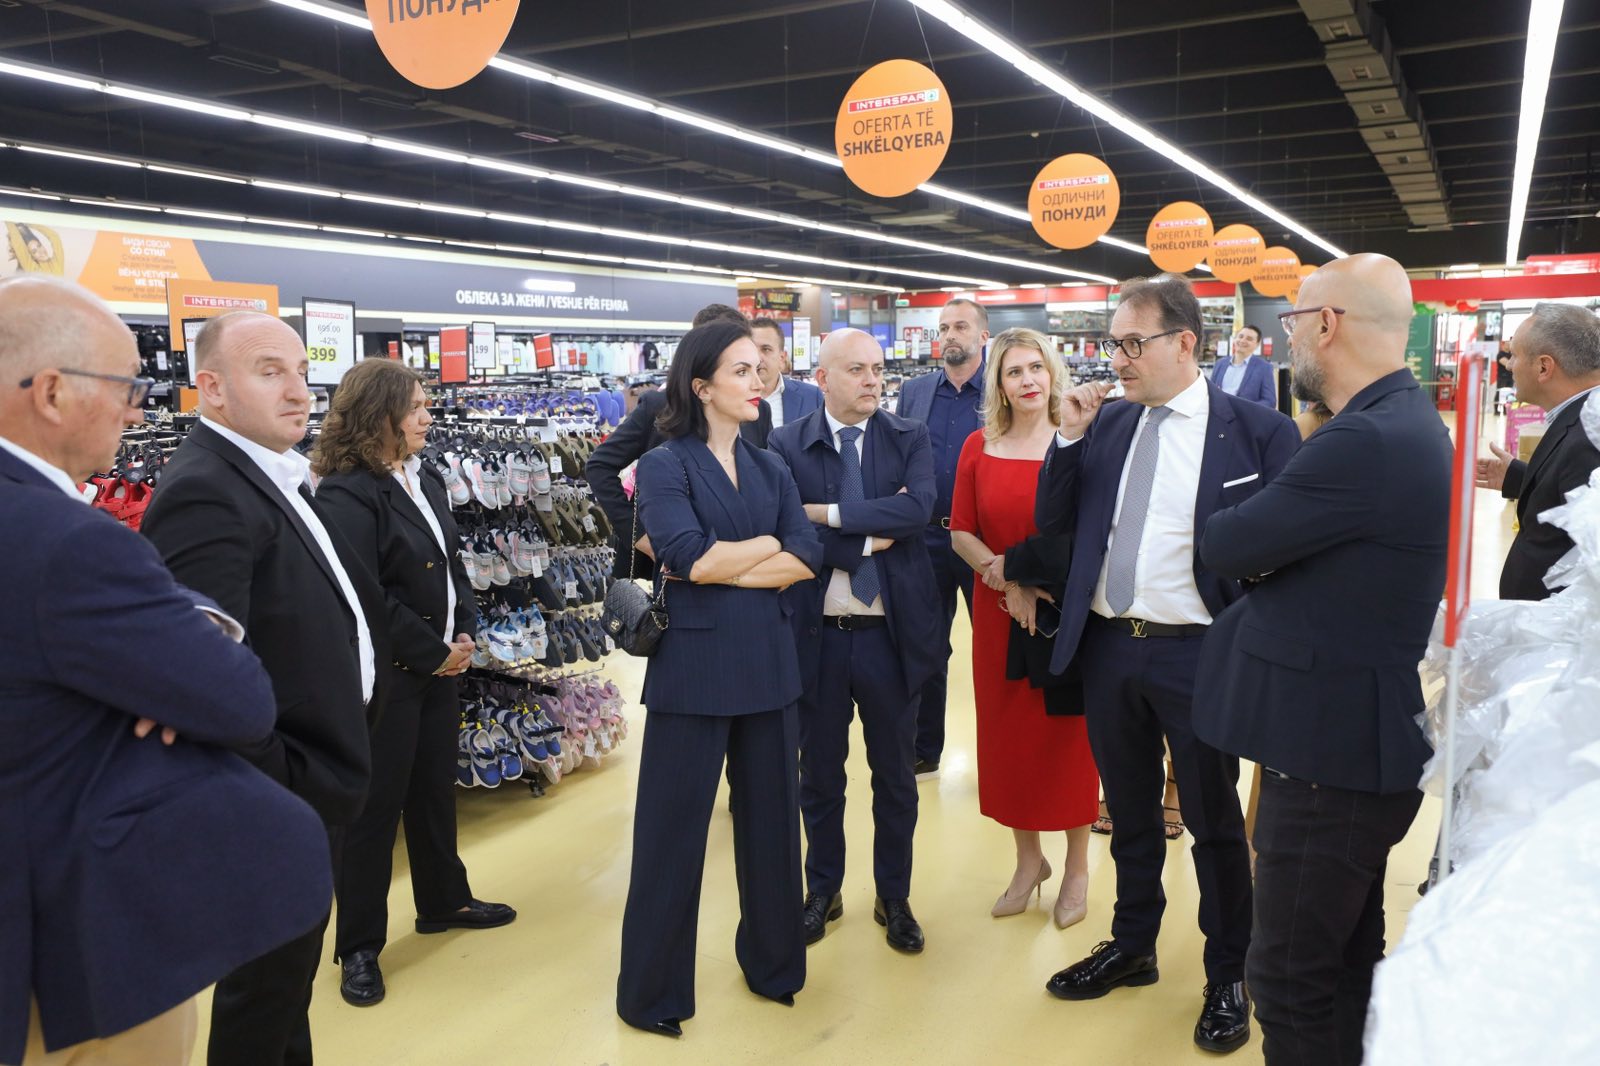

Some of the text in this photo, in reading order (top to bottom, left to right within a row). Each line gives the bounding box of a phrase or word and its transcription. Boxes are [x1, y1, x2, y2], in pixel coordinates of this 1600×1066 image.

[388, 0, 500, 23] ПОНУД
[856, 92, 925, 110] INTERSPAR
[853, 107, 934, 136] OFERTA TË
[843, 130, 945, 157] SHKËLQYERA
[1045, 177, 1098, 188] INTERSPAR
[1042, 190, 1105, 206] ОДЛИЧНИ
[1042, 205, 1106, 222] ПОНУДИ
[1157, 231, 1191, 240] OFERTA
[1151, 239, 1209, 251] SHKËLQYERA
[1215, 256, 1256, 266] ПОНУДИ
[191, 297, 255, 308] INTERSPAR
[456, 290, 500, 306] ОБЛЕКА
[501, 292, 514, 306] ЗА
[515, 293, 545, 308] ЖЕНИ
[584, 296, 600, 310] PËR
[601, 298, 629, 312] FEMRA
[309, 347, 336, 361] 399
[475, 345, 488, 354] 199
